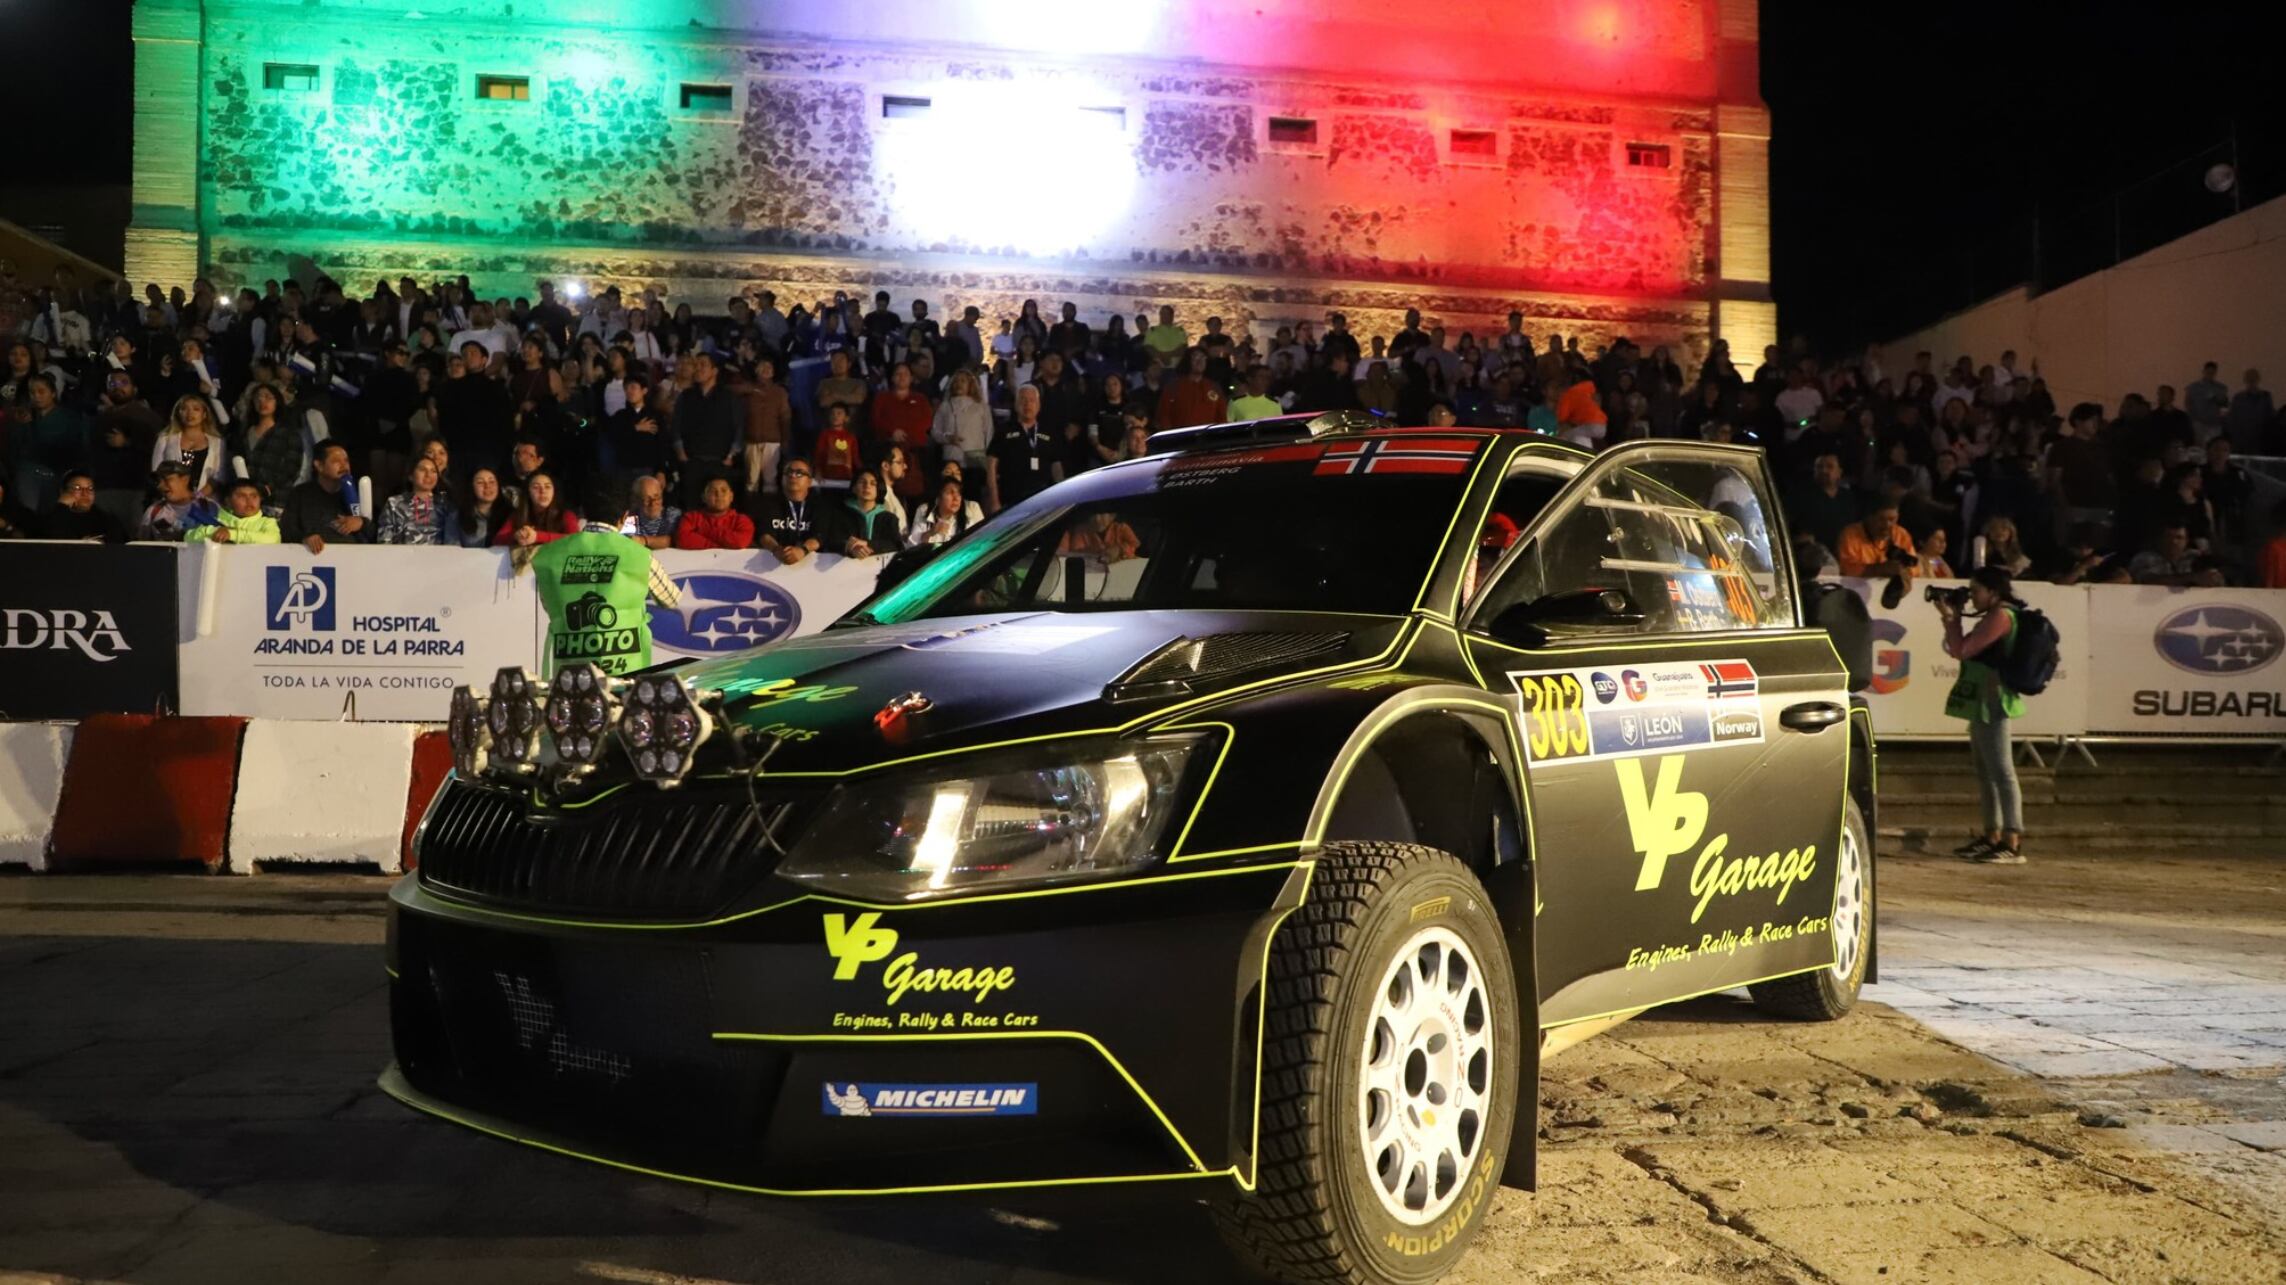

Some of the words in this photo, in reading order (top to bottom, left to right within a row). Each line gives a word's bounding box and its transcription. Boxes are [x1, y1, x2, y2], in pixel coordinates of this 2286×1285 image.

[353, 616, 440, 632] HOSPITAL
[254, 638, 334, 655] ARANDA
[342, 640, 365, 655] DE
[373, 640, 397, 656] LA
[404, 640, 464, 656] PARRA
[555, 630, 633, 655] PHOTO
[263, 675, 305, 688] TODA
[312, 676, 330, 688] LA
[336, 676, 373, 689] VIDA
[379, 676, 454, 689] CONTIGO
[1521, 675, 1590, 759] 303
[1644, 712, 1684, 737] LEÓN
[1716, 722, 1758, 737] Norway
[1614, 754, 1709, 891] VP
[1690, 833, 1816, 924] Garage
[823, 912, 899, 980] VP
[1625, 943, 1692, 972] Engines,
[1698, 929, 1738, 956] Rally
[1739, 926, 1754, 946] &
[1759, 922, 1793, 944] Race
[1797, 915, 1828, 935] Cars
[883, 952, 1016, 1006] Garage
[833, 1012, 893, 1030] Engines,
[898, 1012, 938, 1031] Rally
[941, 1013, 955, 1027] &
[961, 1012, 998, 1027] Race
[1003, 1012, 1039, 1026] Cars
[874, 1089, 1026, 1108] MICHELIN
[1383, 1148, 1495, 1257] SCORPION
